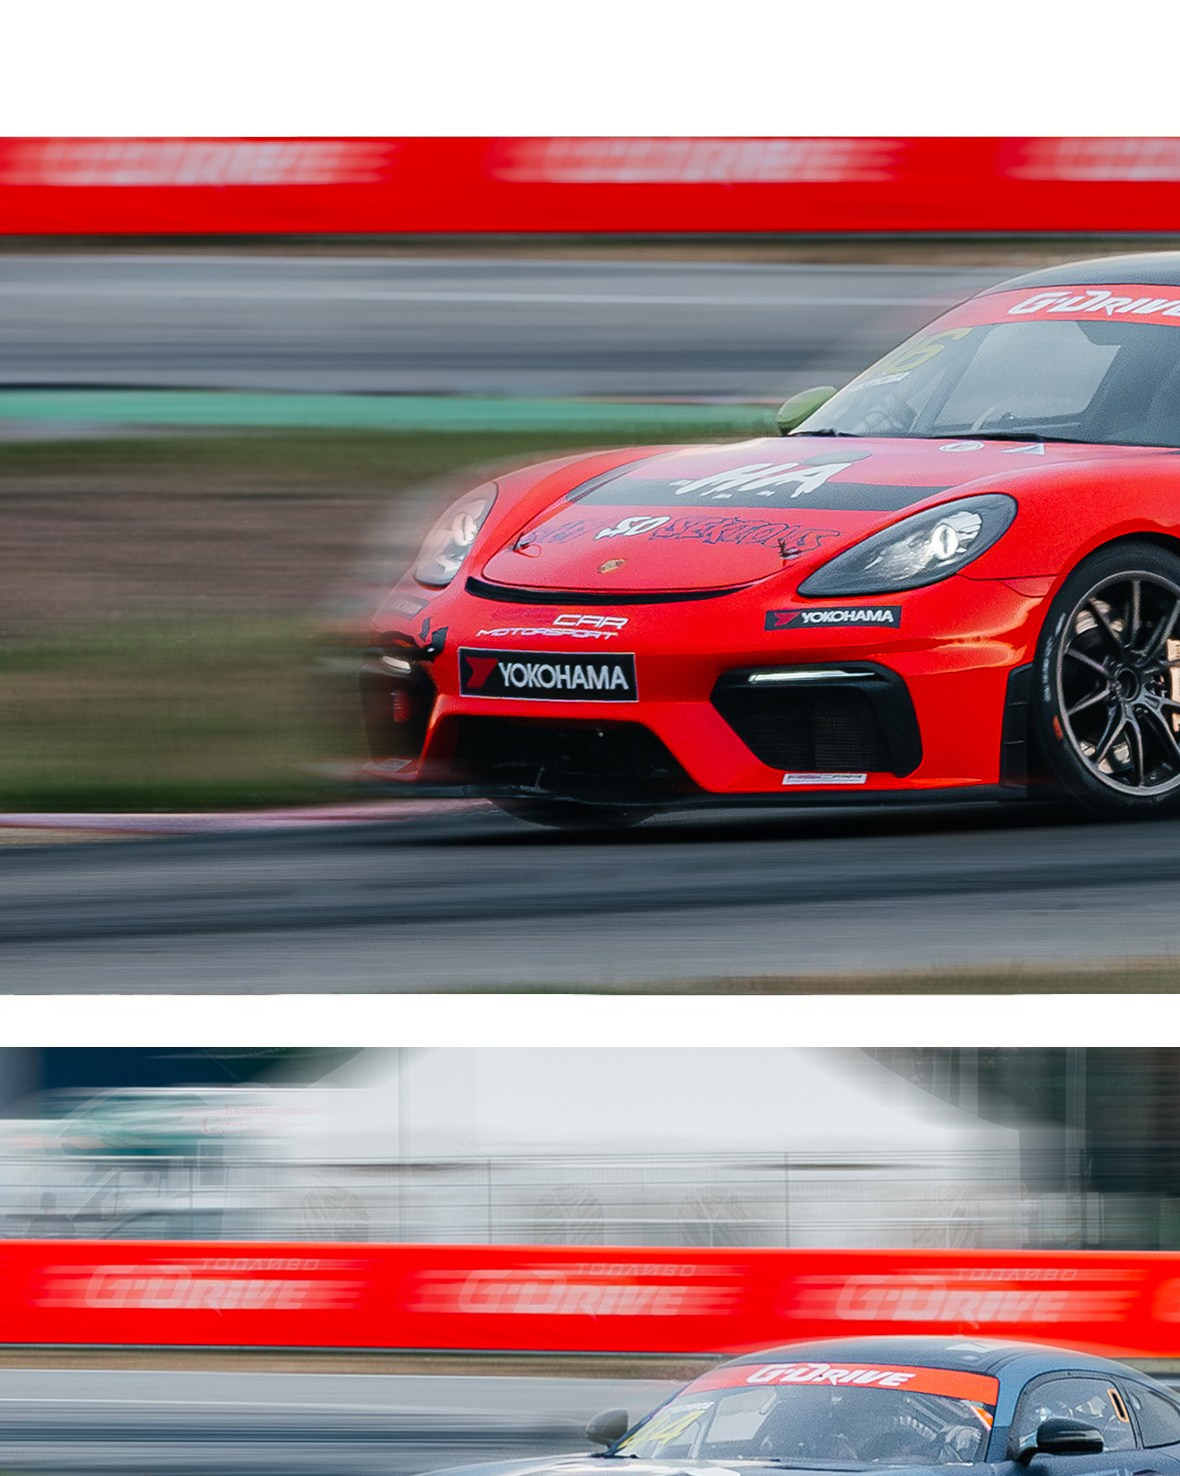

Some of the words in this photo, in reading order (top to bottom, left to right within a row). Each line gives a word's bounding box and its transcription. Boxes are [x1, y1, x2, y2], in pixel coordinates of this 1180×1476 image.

[801, 609, 894, 624] YOKOHAMA
[475, 626, 619, 641] MOTORSPORT
[498, 662, 629, 691] YOKOHAMA
